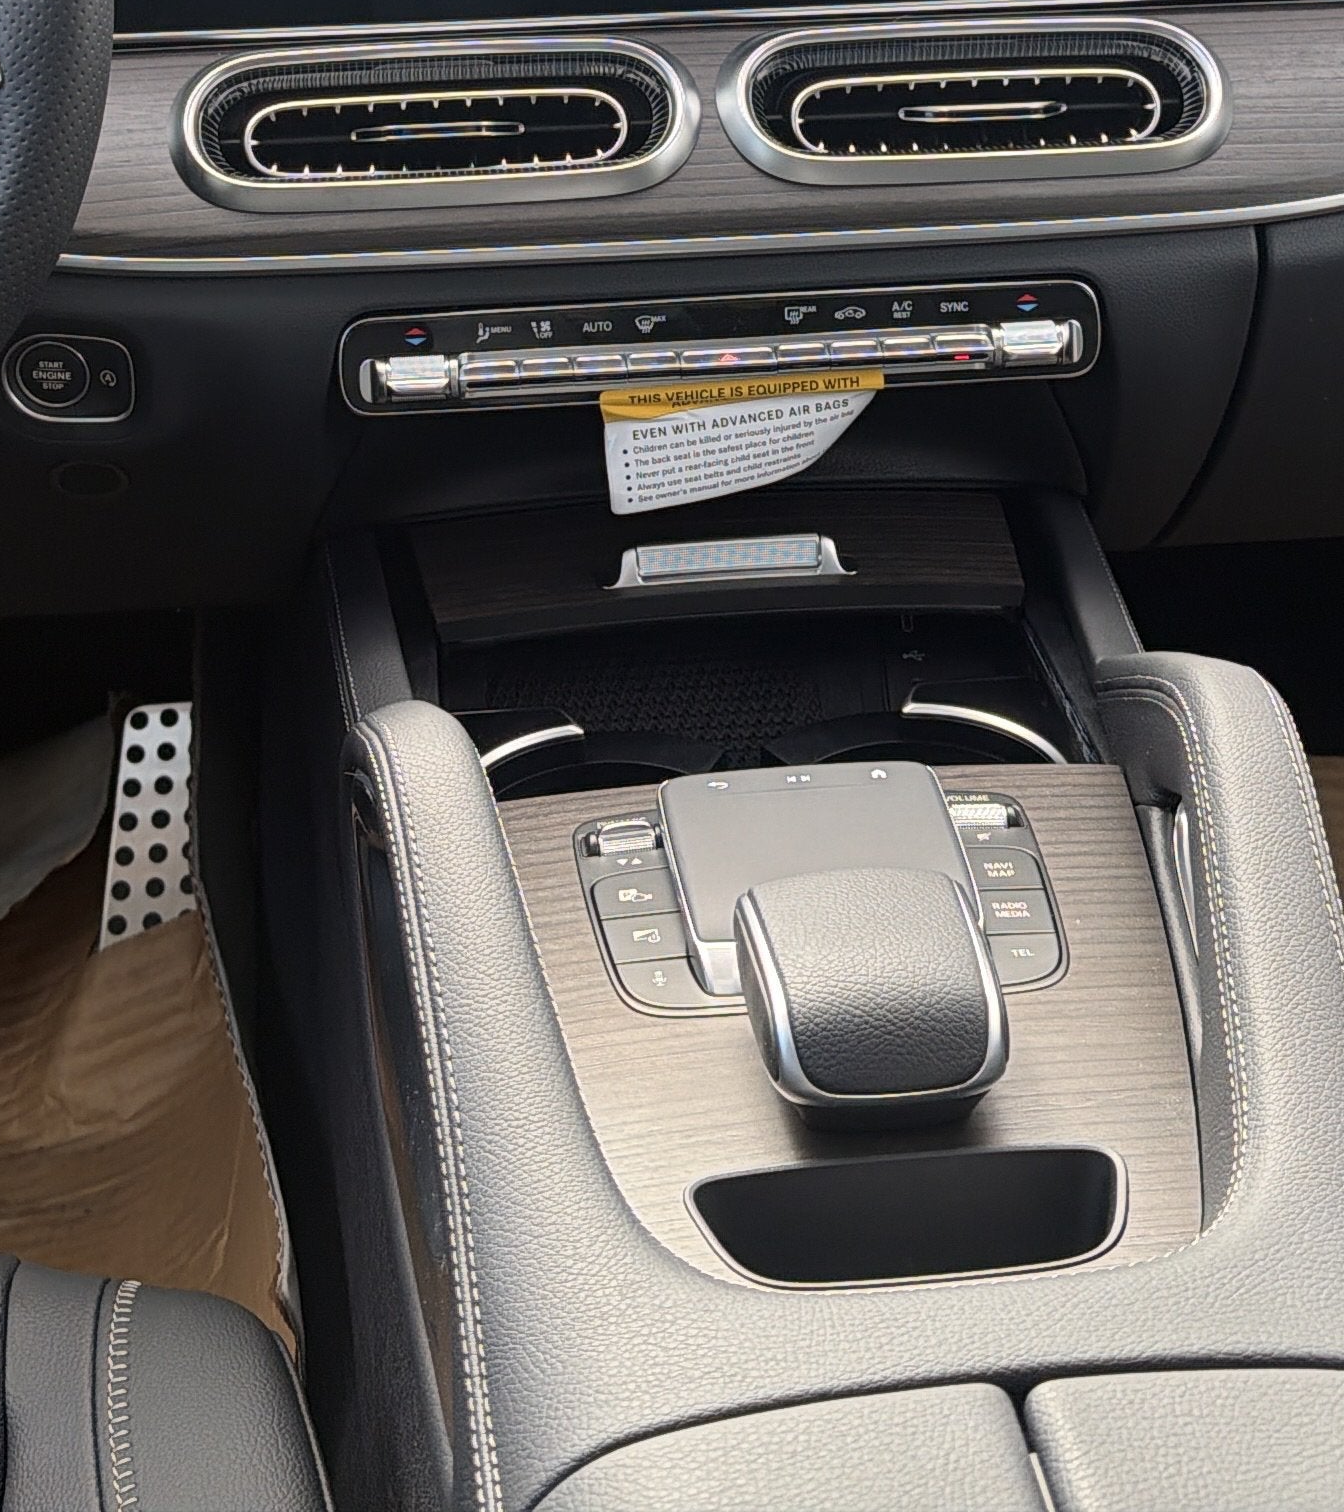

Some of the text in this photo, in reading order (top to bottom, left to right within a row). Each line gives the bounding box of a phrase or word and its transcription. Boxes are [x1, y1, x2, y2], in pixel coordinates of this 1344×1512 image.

[800, 305, 817, 313] REAR
[892, 301, 913, 311] A/C
[940, 301, 969, 313] SYNC
[651, 315, 667, 323] MAX
[893, 311, 911, 319] REST
[490, 326, 512, 334] MENU
[582, 321, 613, 333] AUTO
[540, 331, 553, 339] OFF
[38, 361, 64, 369] START
[32, 370, 72, 381] ENGINE
[42, 382, 65, 390] STOP
[628, 393, 662, 405] THIS
[665, 387, 726, 402] VEHICLE
[730, 386, 744, 398] IS
[748, 380, 819, 397] EQUIPPED
[823, 376, 861, 390] WITH
[632, 398, 850, 440] EVEN WITH ADVANCED AIR BAGS
[633, 443, 668, 455] Children
[669, 440, 685, 450] can
[687, 438, 697, 448] be
[699, 434, 722, 445] killed
[723, 433, 732, 441] or
[734, 426, 772, 439] seriously
[772, 421, 802, 434] injured
[803, 419, 813, 429] by
[814, 415, 828, 425] the
[829, 412, 840, 422] air
[635, 430, 815, 467] The back seat is the safest place for children
[636, 469, 660, 480] Never
[662, 467, 676, 477] put
[684, 458, 729, 472] rear-facing
[731, 454, 751, 464] child
[752, 449, 770, 459] seat
[771, 447, 780, 456] in
[781, 443, 794, 454] the
[795, 440, 815, 451] front
[637, 453, 802, 492] Always use seat belts and child restraints
[638, 493, 654, 503] See
[655, 488, 688, 500] owner's
[689, 482, 720, 494] manual
[721, 478, 732, 488] for
[734, 474, 756, 485] more
[756, 462, 801, 479] information
[983, 862, 1014, 870] NAVI
[987, 870, 1016, 878] MAP
[991, 901, 1028, 910] RADIO
[995, 910, 1031, 918] MEDIA
[1011, 948, 1035, 958] TEL
